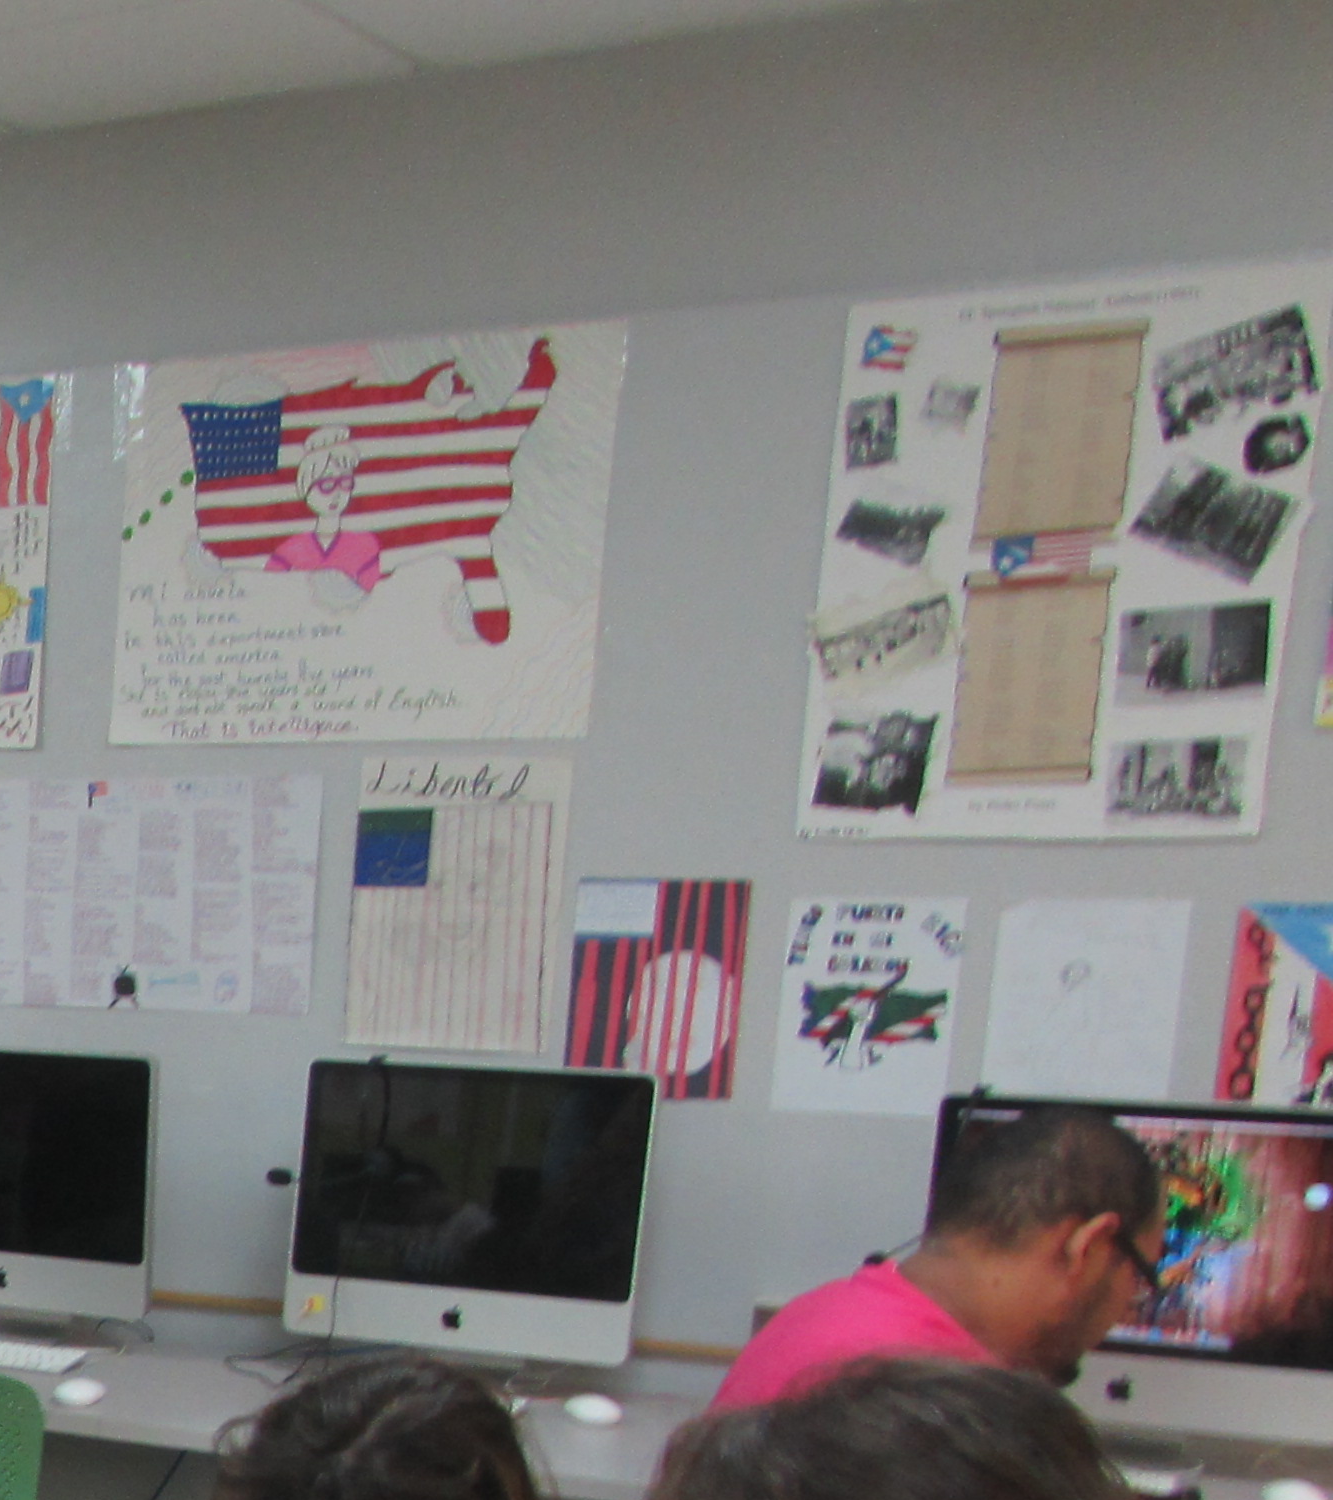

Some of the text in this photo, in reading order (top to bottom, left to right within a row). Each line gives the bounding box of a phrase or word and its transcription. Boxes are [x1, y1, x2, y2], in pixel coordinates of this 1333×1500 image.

[155, 630, 196, 648] this
[313, 697, 356, 712] word
[365, 690, 383, 711] of
[162, 720, 209, 740] That
